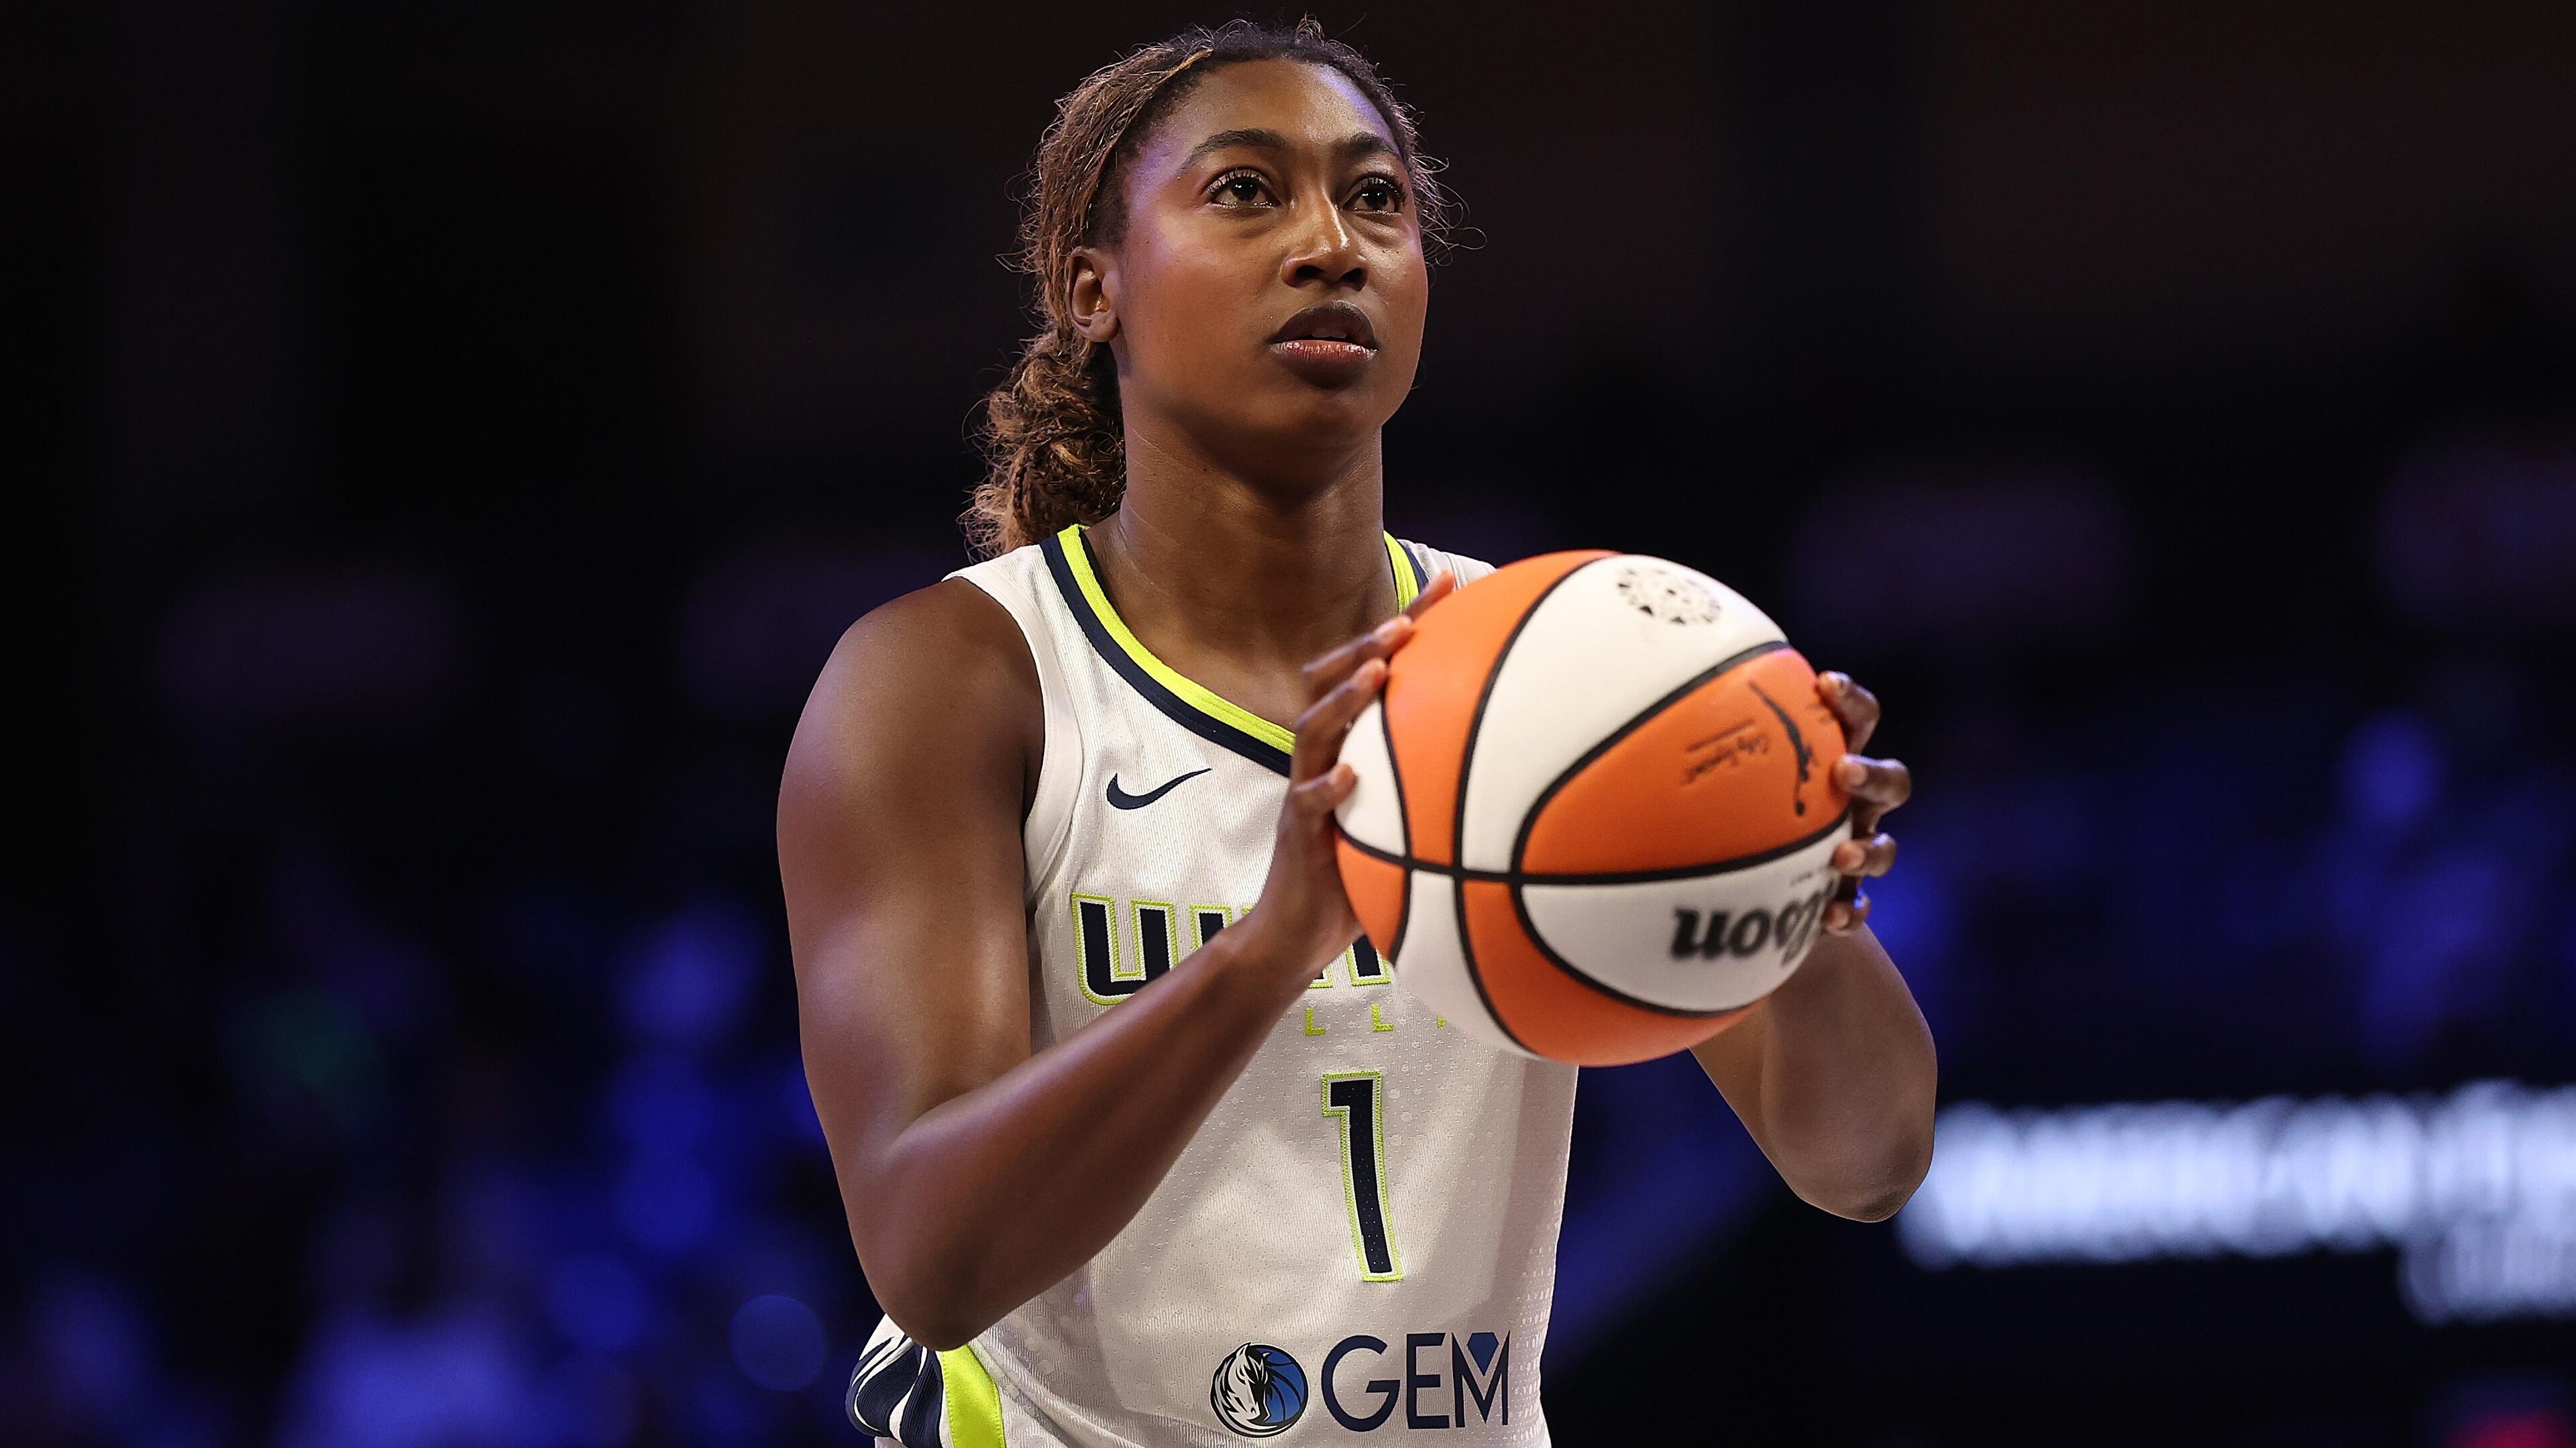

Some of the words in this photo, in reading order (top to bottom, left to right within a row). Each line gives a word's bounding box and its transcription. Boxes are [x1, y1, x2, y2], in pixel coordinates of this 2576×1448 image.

[1670, 883, 1834, 966] lson
[1322, 1071, 1403, 1281] 1
[1321, 1329, 1511, 1433] GEM
